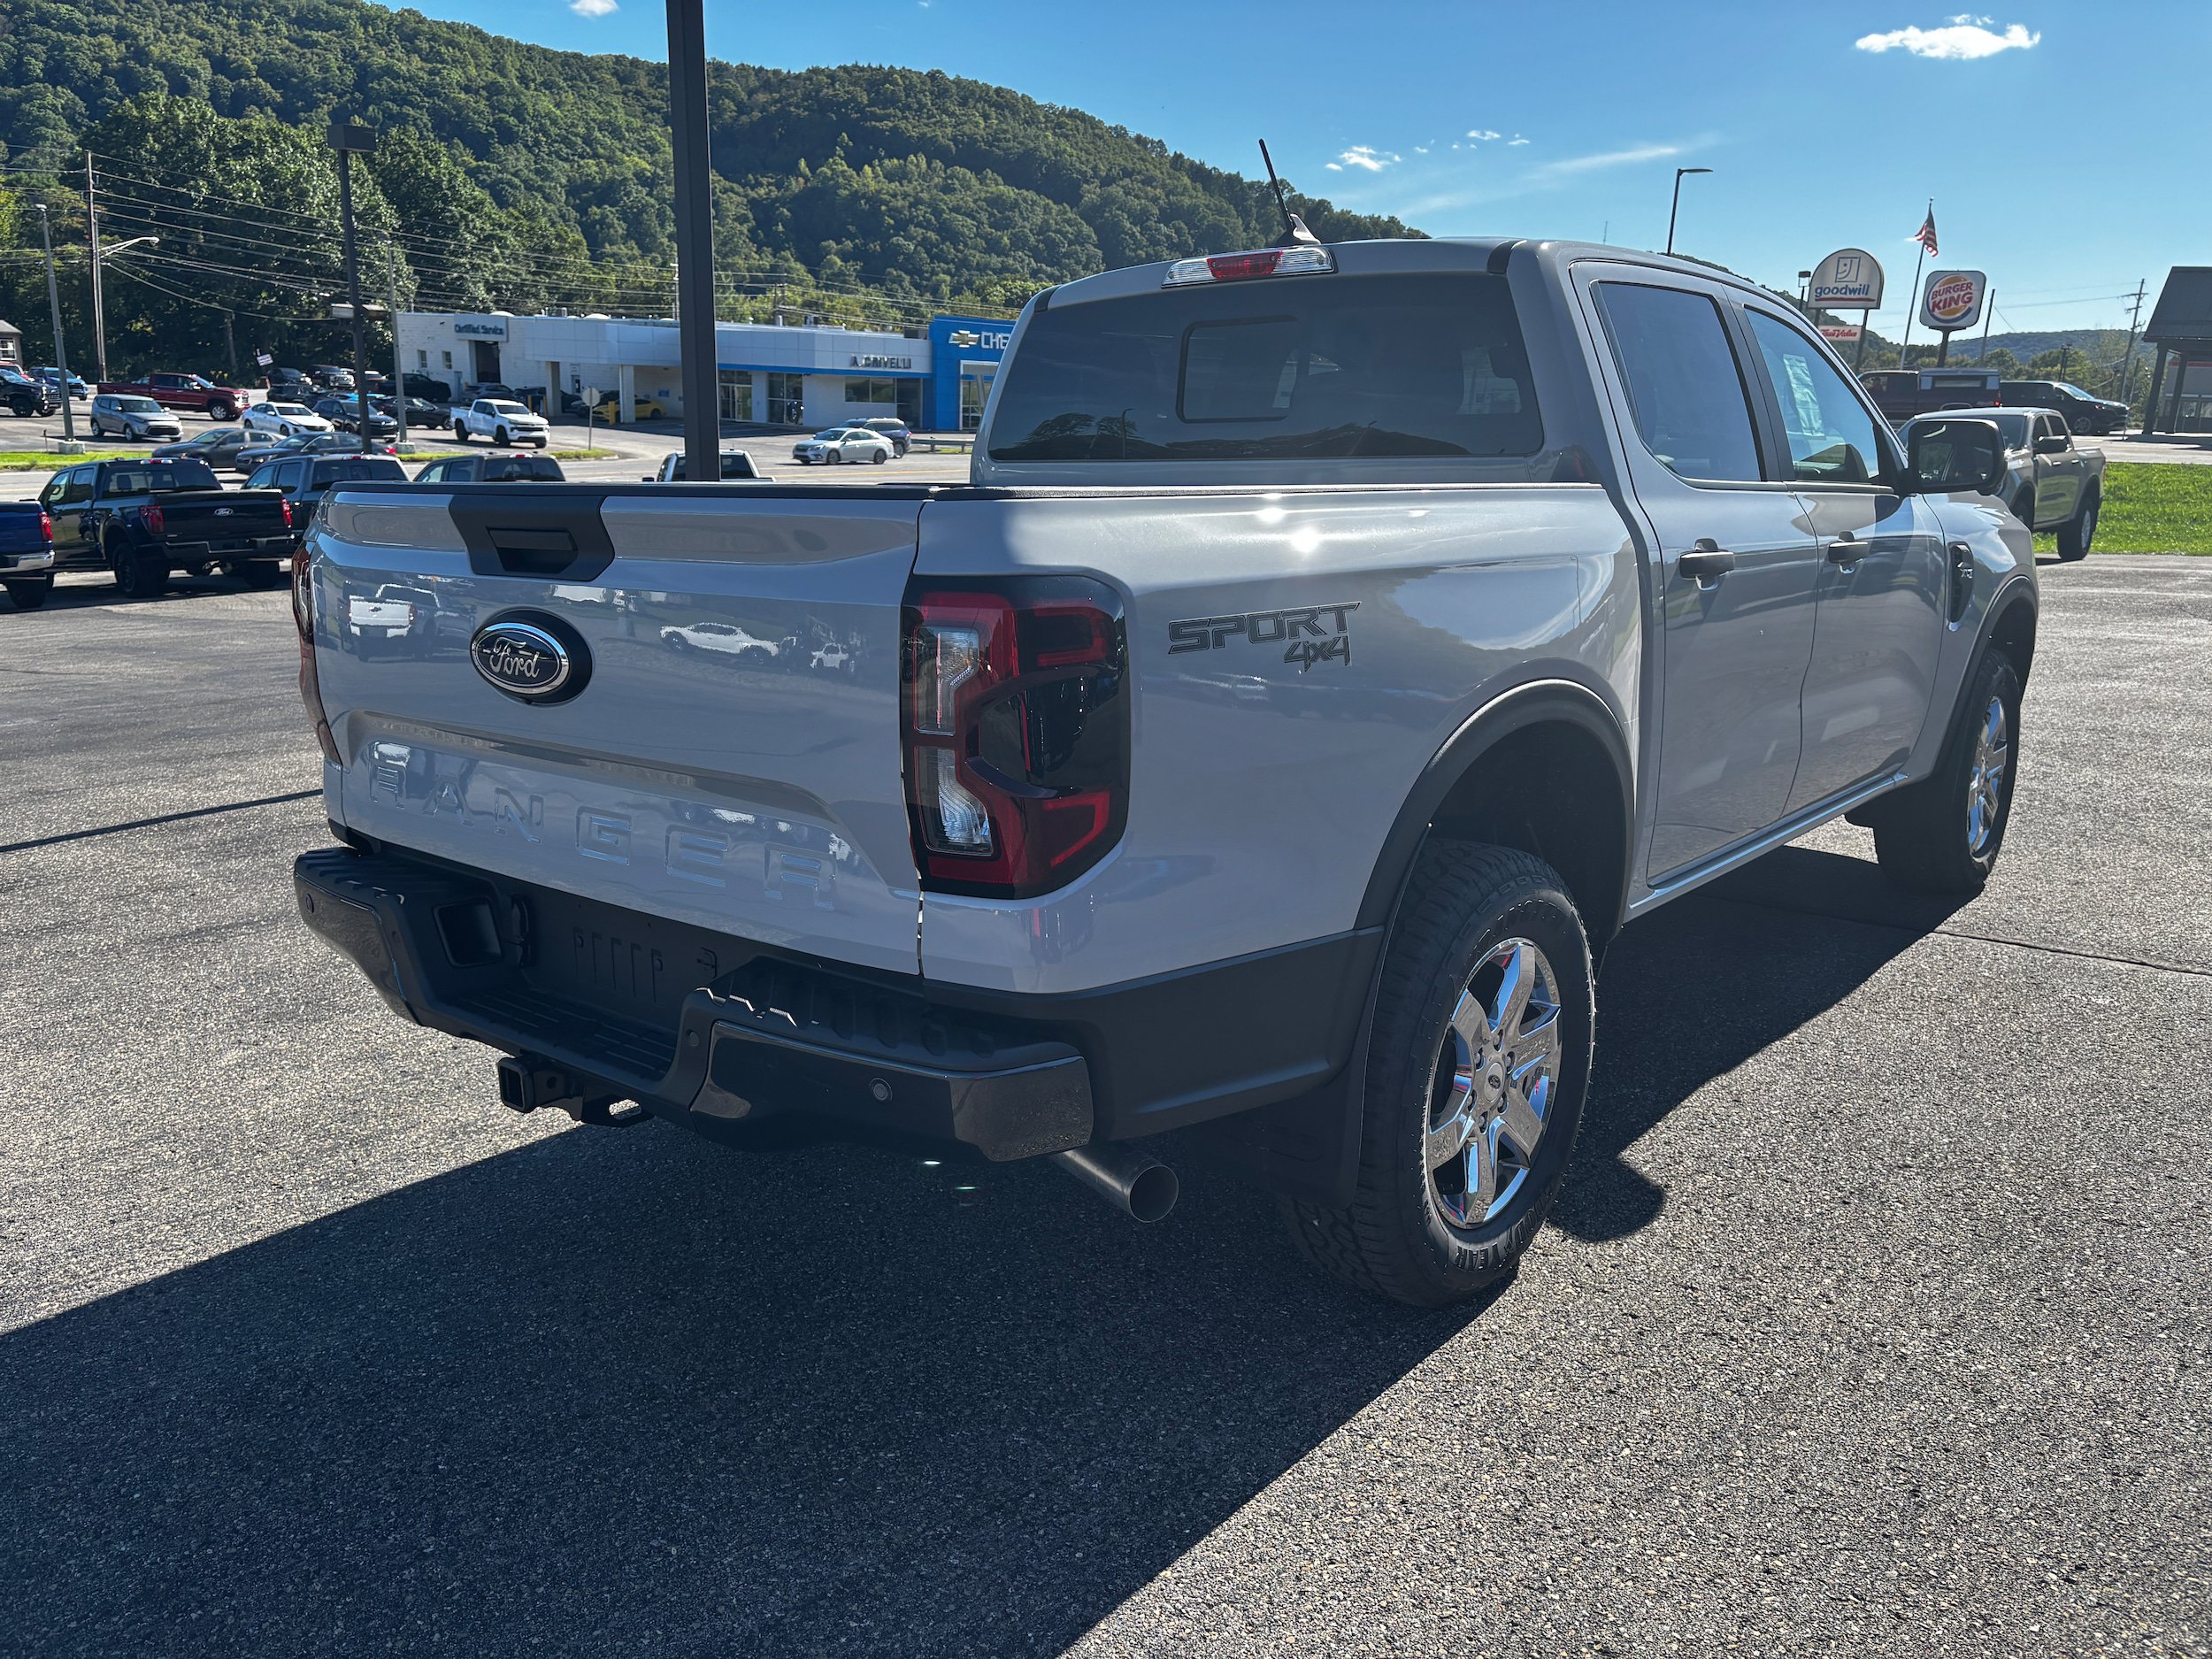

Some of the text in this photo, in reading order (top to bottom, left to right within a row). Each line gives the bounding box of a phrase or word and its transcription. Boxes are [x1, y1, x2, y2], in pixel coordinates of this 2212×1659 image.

[1815, 284, 1870, 298] goodwill
[1931, 280, 1974, 299] BURGER
[1931, 291, 1974, 313] KING
[454, 324, 504, 335] Certified Service
[1168, 601, 1363, 655] SPORT
[488, 636, 541, 679] Ford
[368, 741, 837, 912] RANGER
